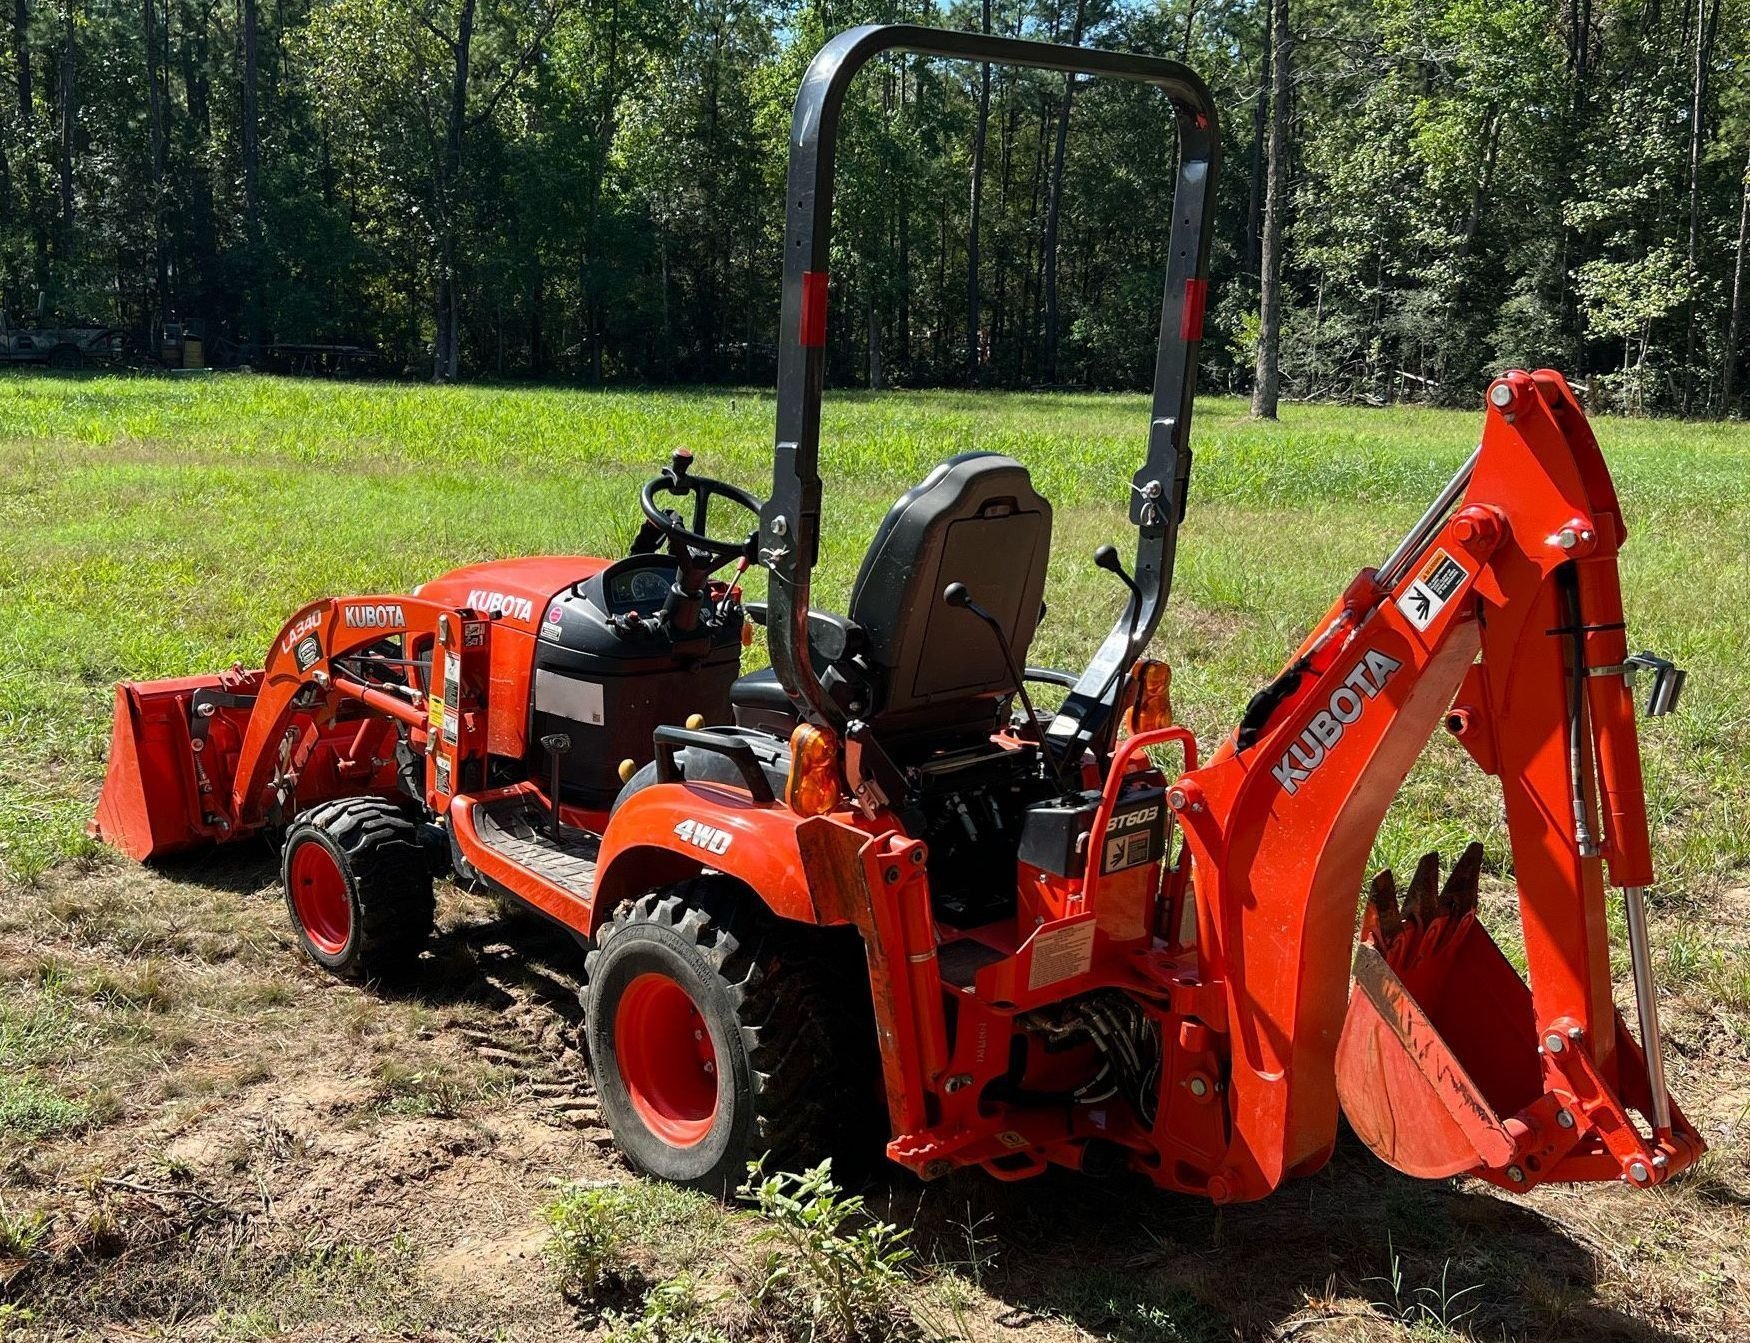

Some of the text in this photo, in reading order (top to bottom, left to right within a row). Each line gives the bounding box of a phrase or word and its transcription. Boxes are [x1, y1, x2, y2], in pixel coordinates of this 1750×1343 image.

[345, 604, 406, 628] KUBOTA
[466, 589, 533, 623] KUBOTA
[281, 610, 322, 655] LA340
[1270, 649, 1403, 795] KUBOTA
[673, 818, 734, 856] 4WD
